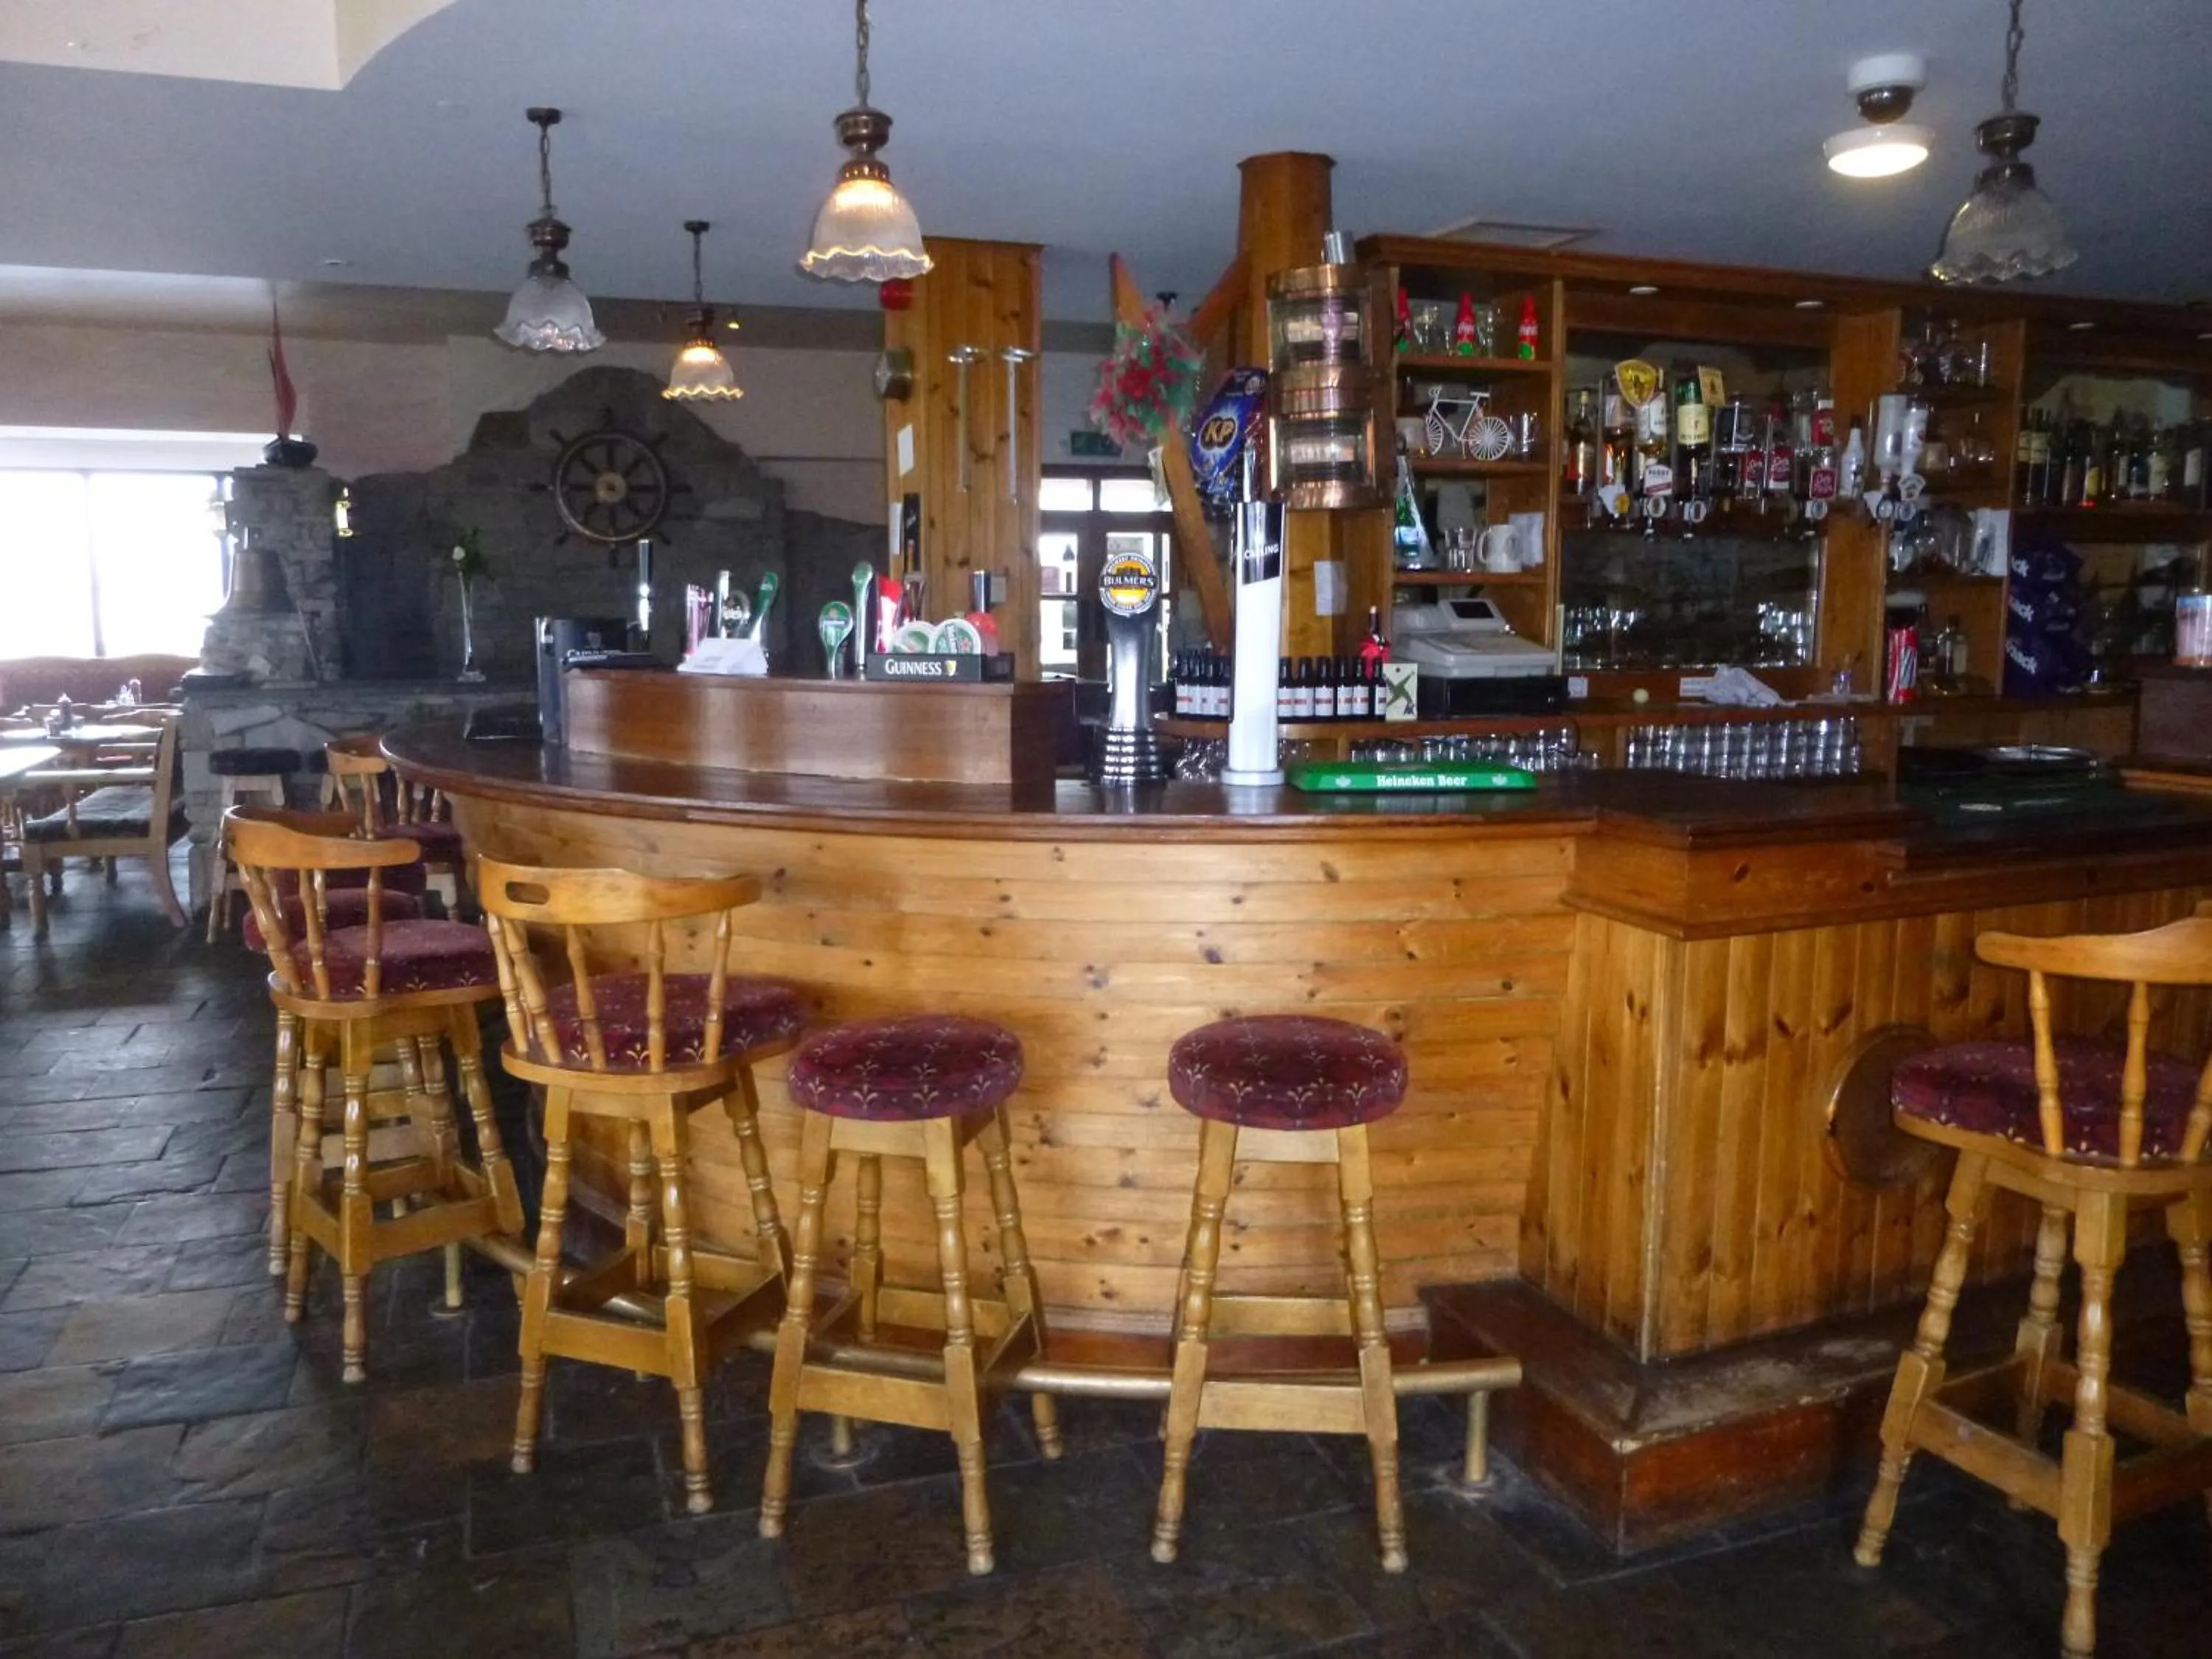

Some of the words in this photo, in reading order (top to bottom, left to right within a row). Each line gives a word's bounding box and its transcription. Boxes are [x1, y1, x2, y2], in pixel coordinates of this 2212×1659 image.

[1204, 419, 1236, 445] KP
[1244, 543, 1279, 560] CALING
[1104, 575, 1154, 587] BULMERS
[885, 658, 942, 676] GUINNESS
[1377, 774, 1434, 787] Heineken
[1438, 774, 1468, 787] Beer
